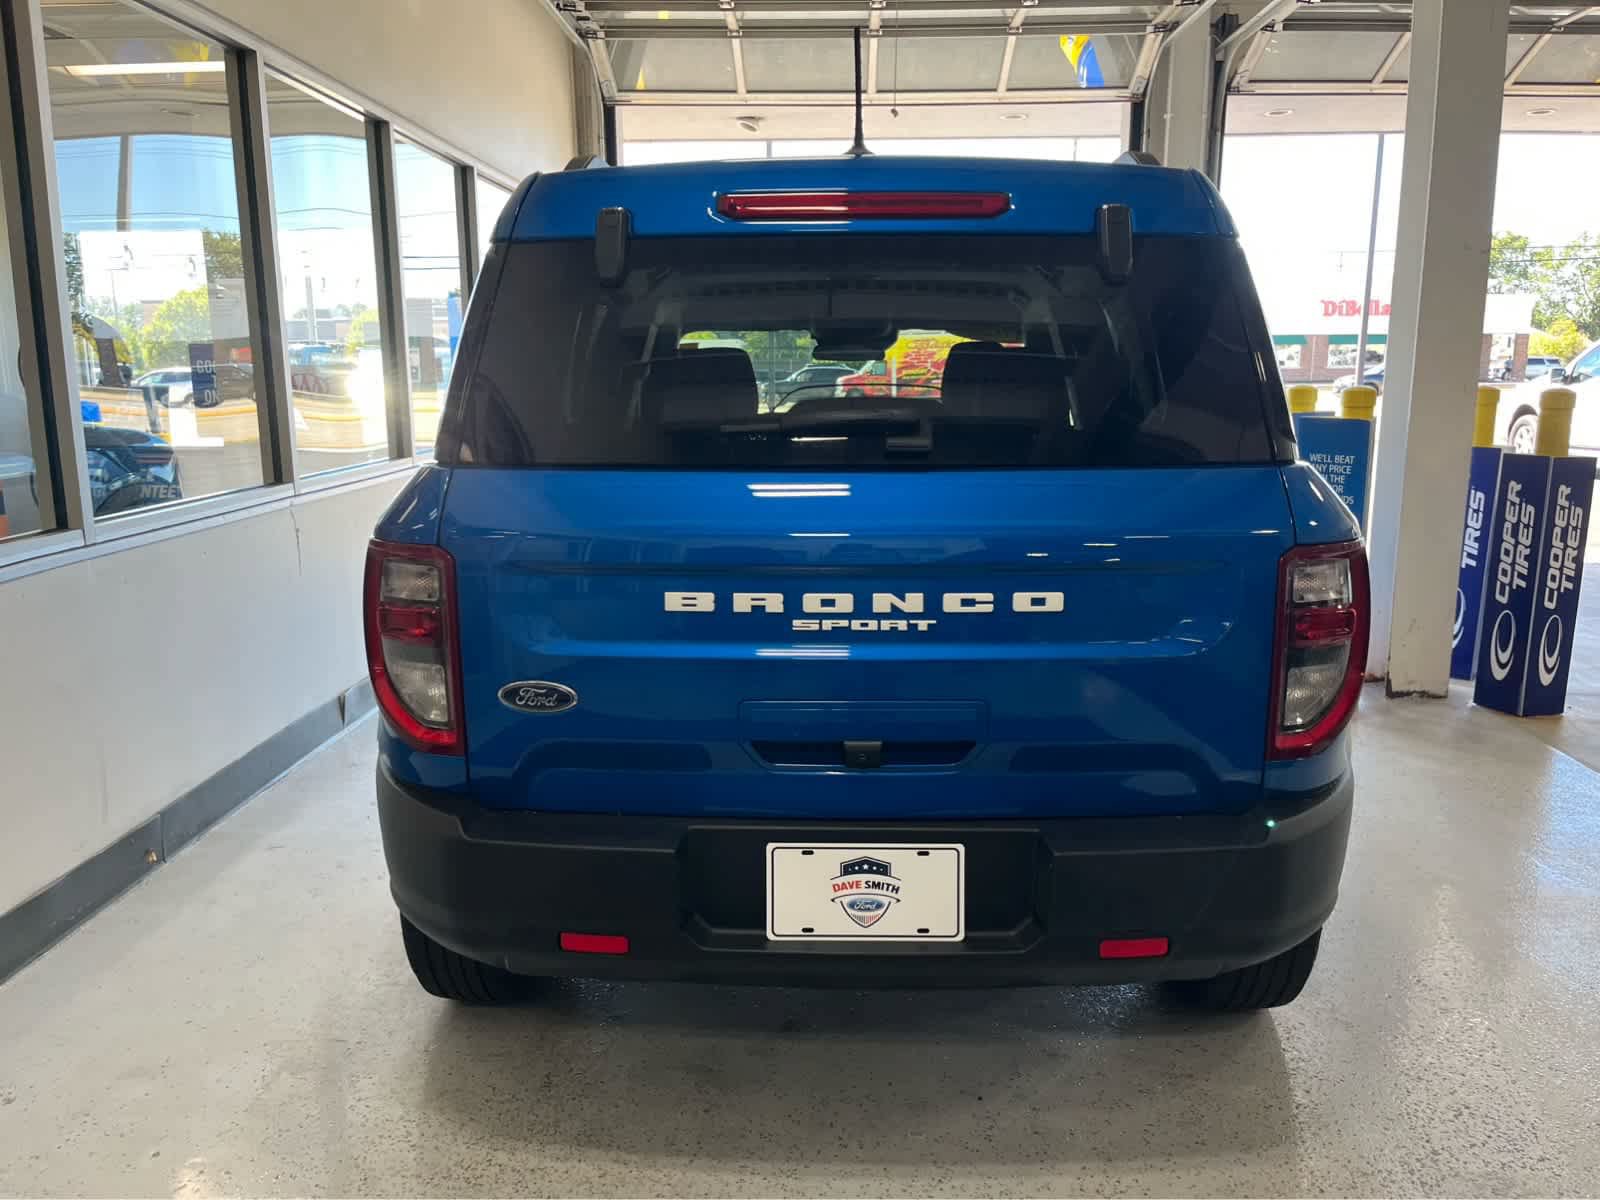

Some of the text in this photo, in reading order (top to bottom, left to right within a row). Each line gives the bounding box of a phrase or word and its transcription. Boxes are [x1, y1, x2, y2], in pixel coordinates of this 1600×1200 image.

[1328, 464, 1352, 474] PRICE
[1334, 455, 1356, 465] BEAT
[1330, 474, 1346, 484] THE
[1461, 488, 1486, 569] TIRES
[1495, 480, 1523, 604] COOPER
[1512, 501, 1536, 590] TIRES
[1543, 483, 1572, 610] COOPER
[1560, 504, 1584, 593] TIRES
[663, 591, 1066, 614] BRONCO
[792, 618, 938, 632] SPORT
[515, 686, 559, 707] Ford
[831, 880, 901, 895] DAVE SMITH
[853, 898, 880, 910] Ford
